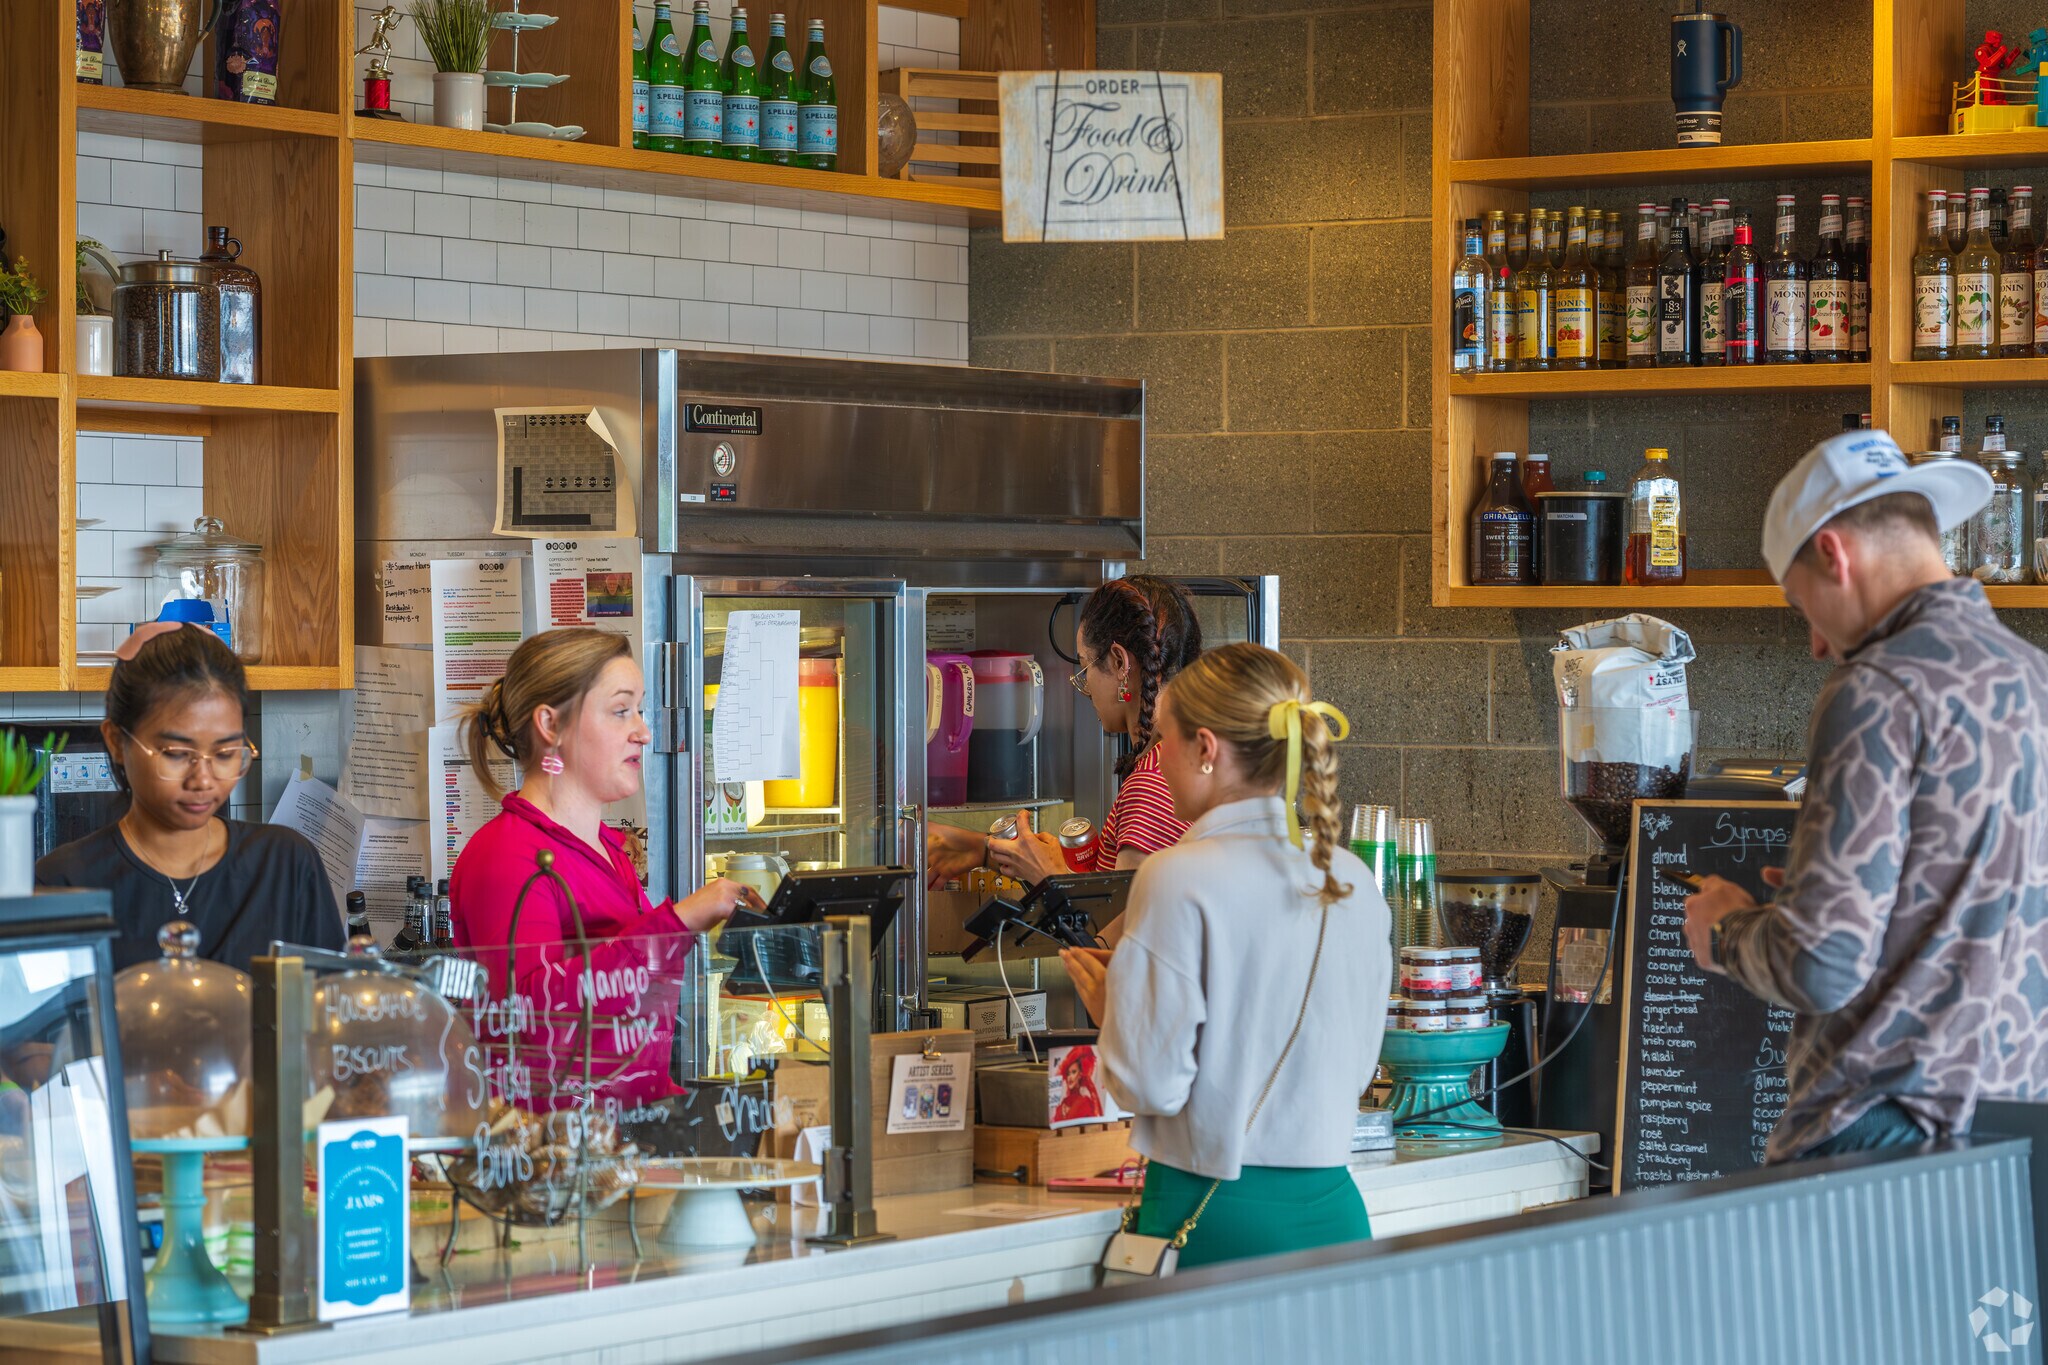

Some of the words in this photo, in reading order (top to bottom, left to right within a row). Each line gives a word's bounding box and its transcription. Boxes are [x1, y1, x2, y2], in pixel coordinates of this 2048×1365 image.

[1085, 80, 1140, 95] ORDER
[1044, 98, 1142, 153] Food
[1140, 112, 1184, 155] &
[1058, 151, 1176, 207] Drink
[693, 404, 757, 427] Continental
[1710, 812, 1792, 863] Syrups:
[1652, 843, 1688, 865] almond
[1647, 945, 1695, 958] cinnamon
[1647, 962, 1686, 972] coconut
[1645, 974, 1678, 985] cookie
[1680, 976, 1707, 986] butter
[577, 965, 649, 1017] Mango
[472, 988, 537, 1040] Pecan
[1642, 1021, 1685, 1034] hazelnut
[1667, 1038, 1697, 1049] cream
[908, 1066, 930, 1077] ARTIST
[931, 1065, 954, 1077] SERIES
[1641, 1065, 1685, 1078] lavender
[1641, 1080, 1698, 1094] peppermint
[1640, 1098, 1684, 1111] pumpkin
[1686, 1100, 1712, 1113] spice
[1640, 1113, 1689, 1134] raspberry
[1640, 1128, 1663, 1139] rose
[1669, 1143, 1708, 1154] caramel
[1635, 1166, 1672, 1181] toasted
